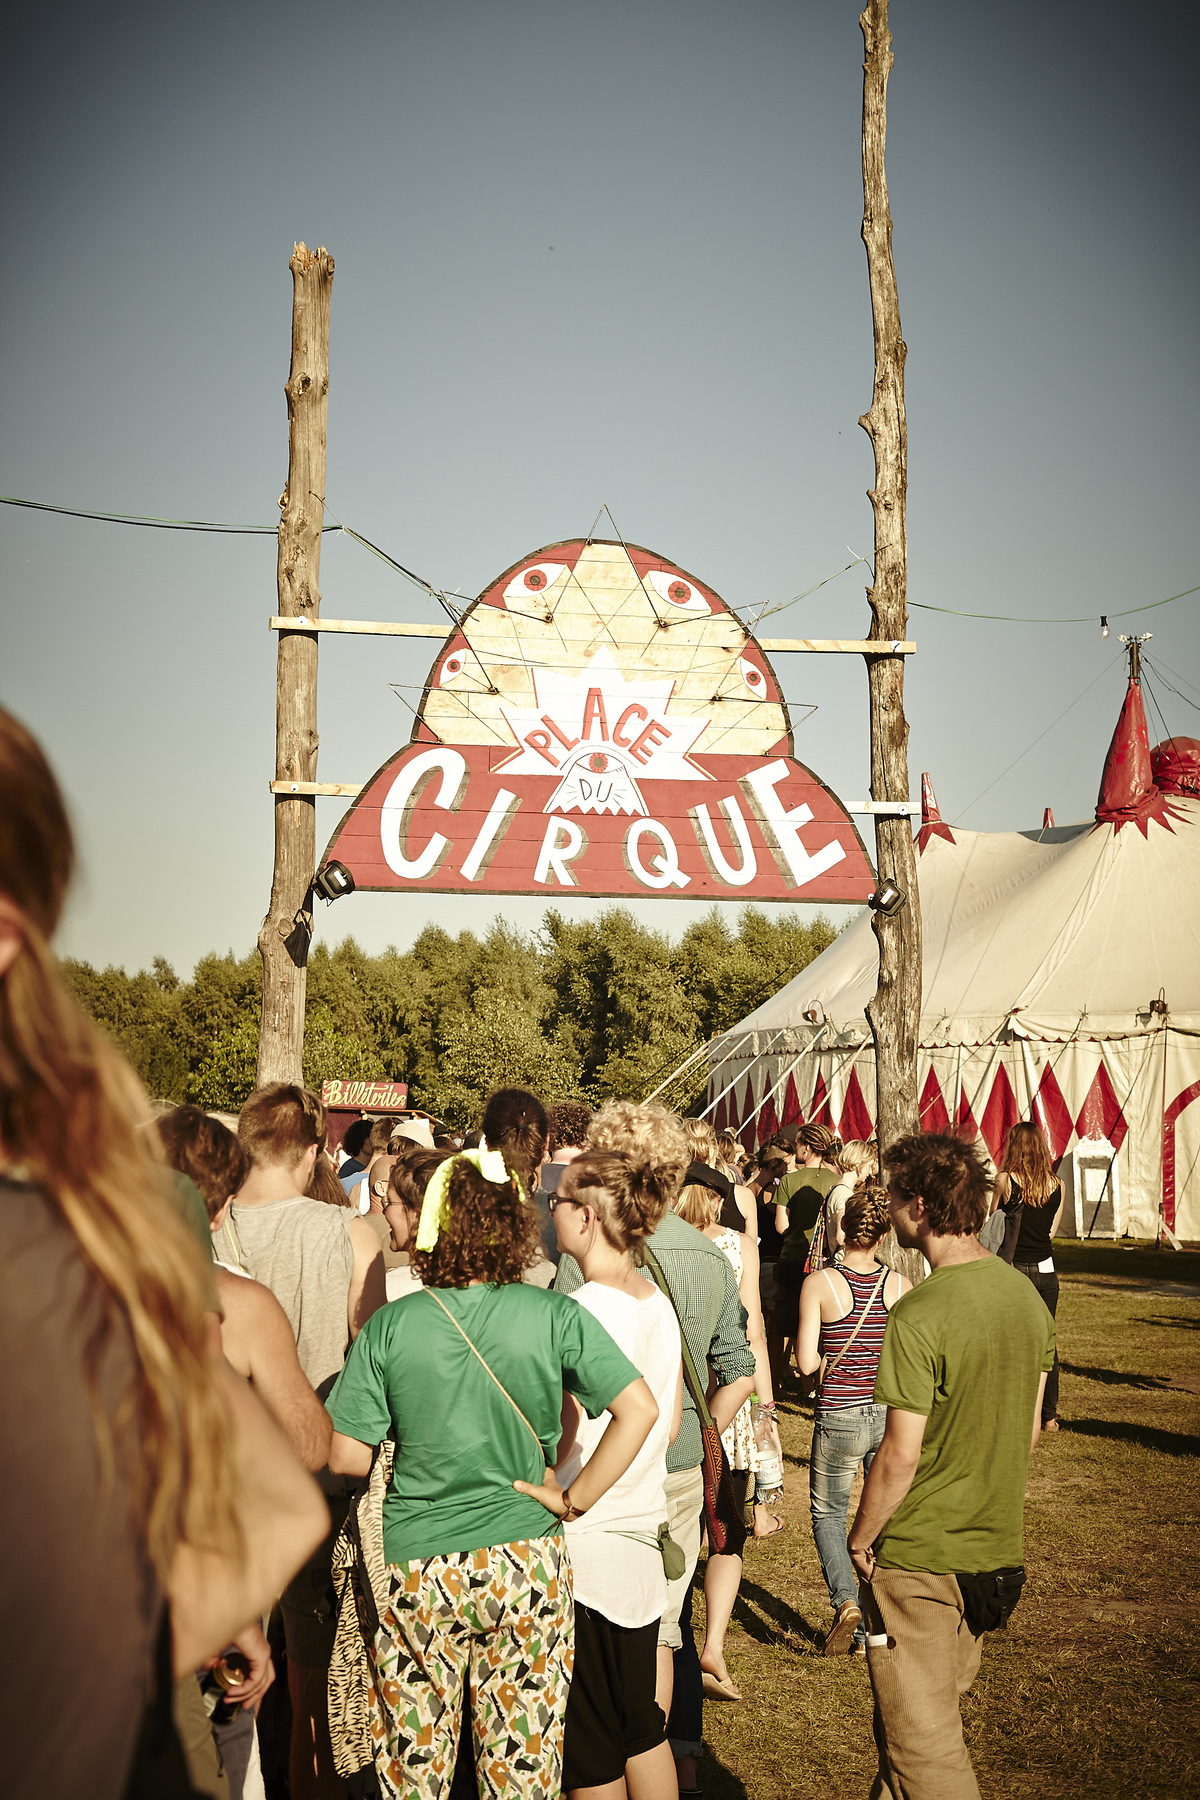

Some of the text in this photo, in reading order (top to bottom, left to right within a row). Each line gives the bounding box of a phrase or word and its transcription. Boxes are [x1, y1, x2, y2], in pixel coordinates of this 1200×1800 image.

[525, 687, 672, 766] PLACE
[380, 747, 847, 890] CIRQUE
[579, 777, 612, 803] DU
